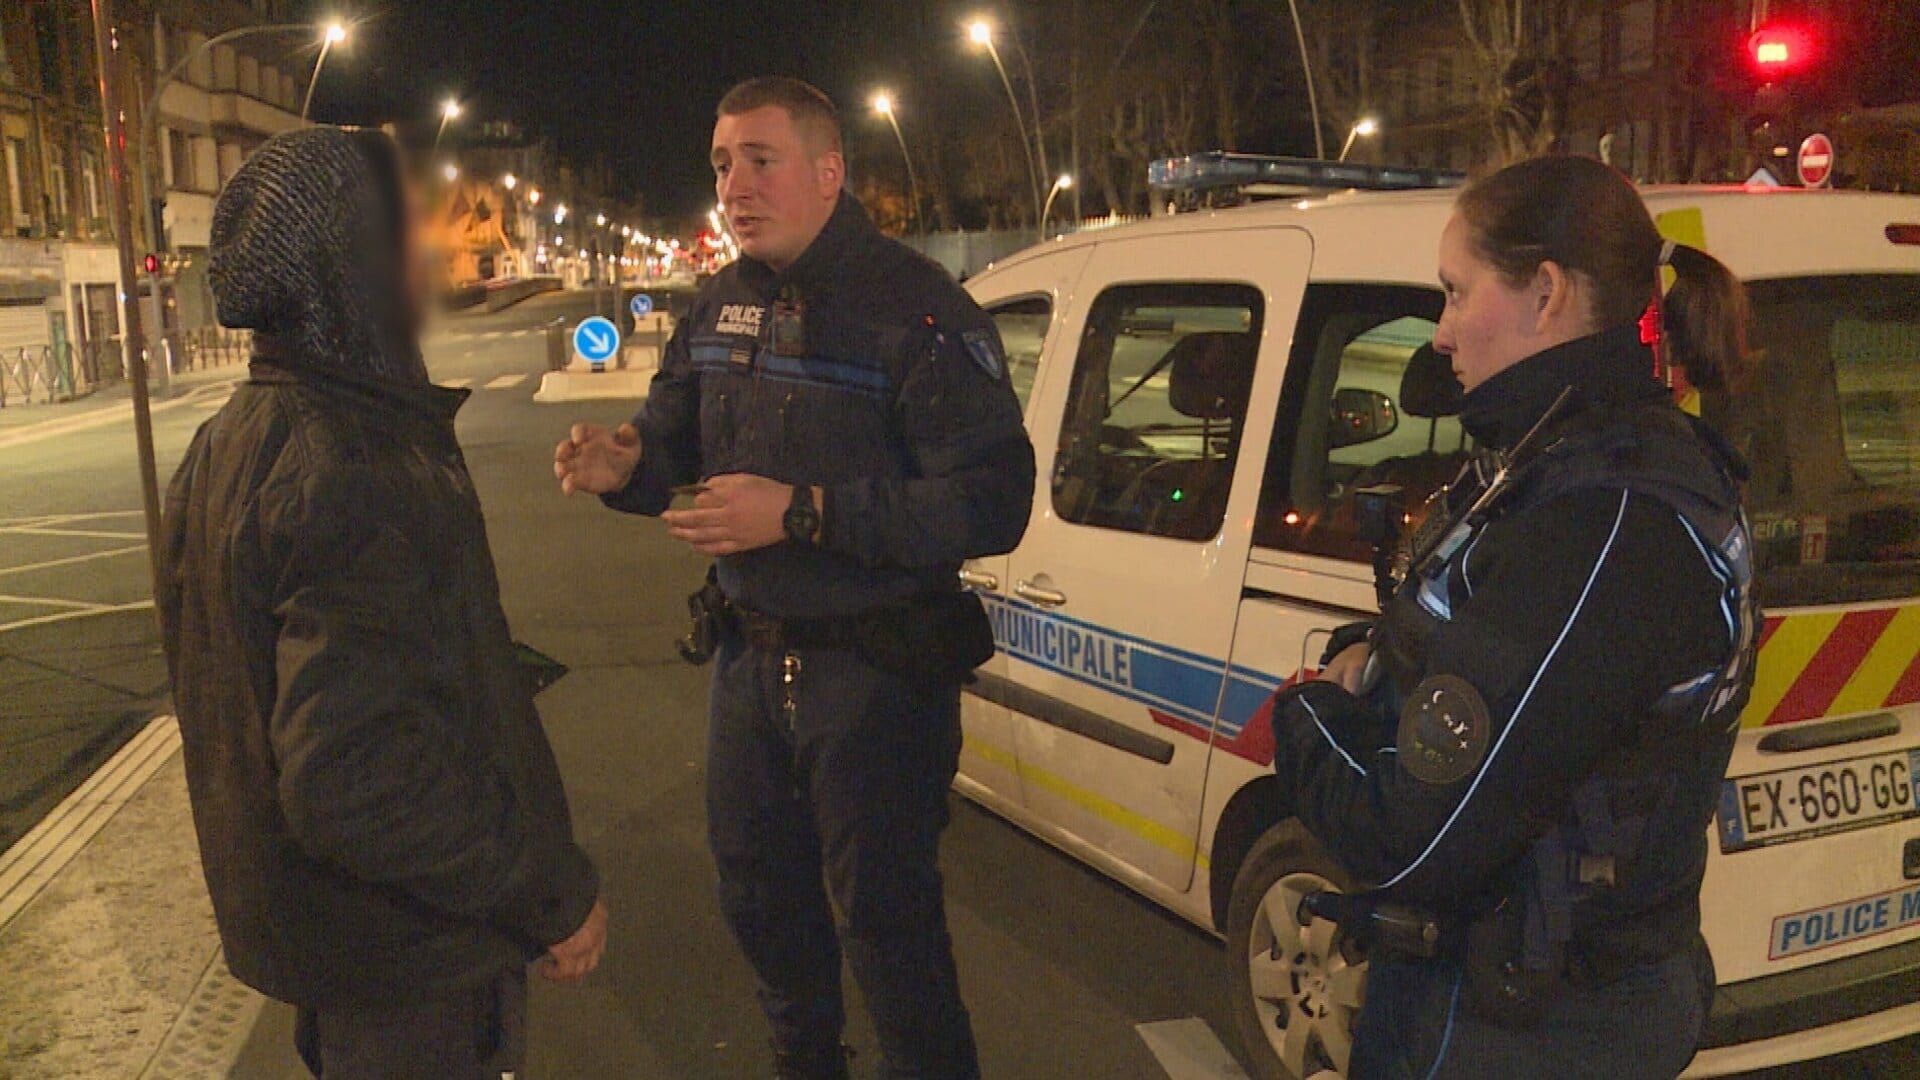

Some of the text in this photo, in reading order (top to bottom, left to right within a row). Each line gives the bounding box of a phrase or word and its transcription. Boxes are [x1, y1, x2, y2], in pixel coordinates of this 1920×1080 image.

[719, 305, 766, 324] POLICE
[987, 604, 1130, 685] MUNICIPALE
[1741, 759, 1910, 833] EX-660-GG
[1781, 897, 1890, 951] POLICE
